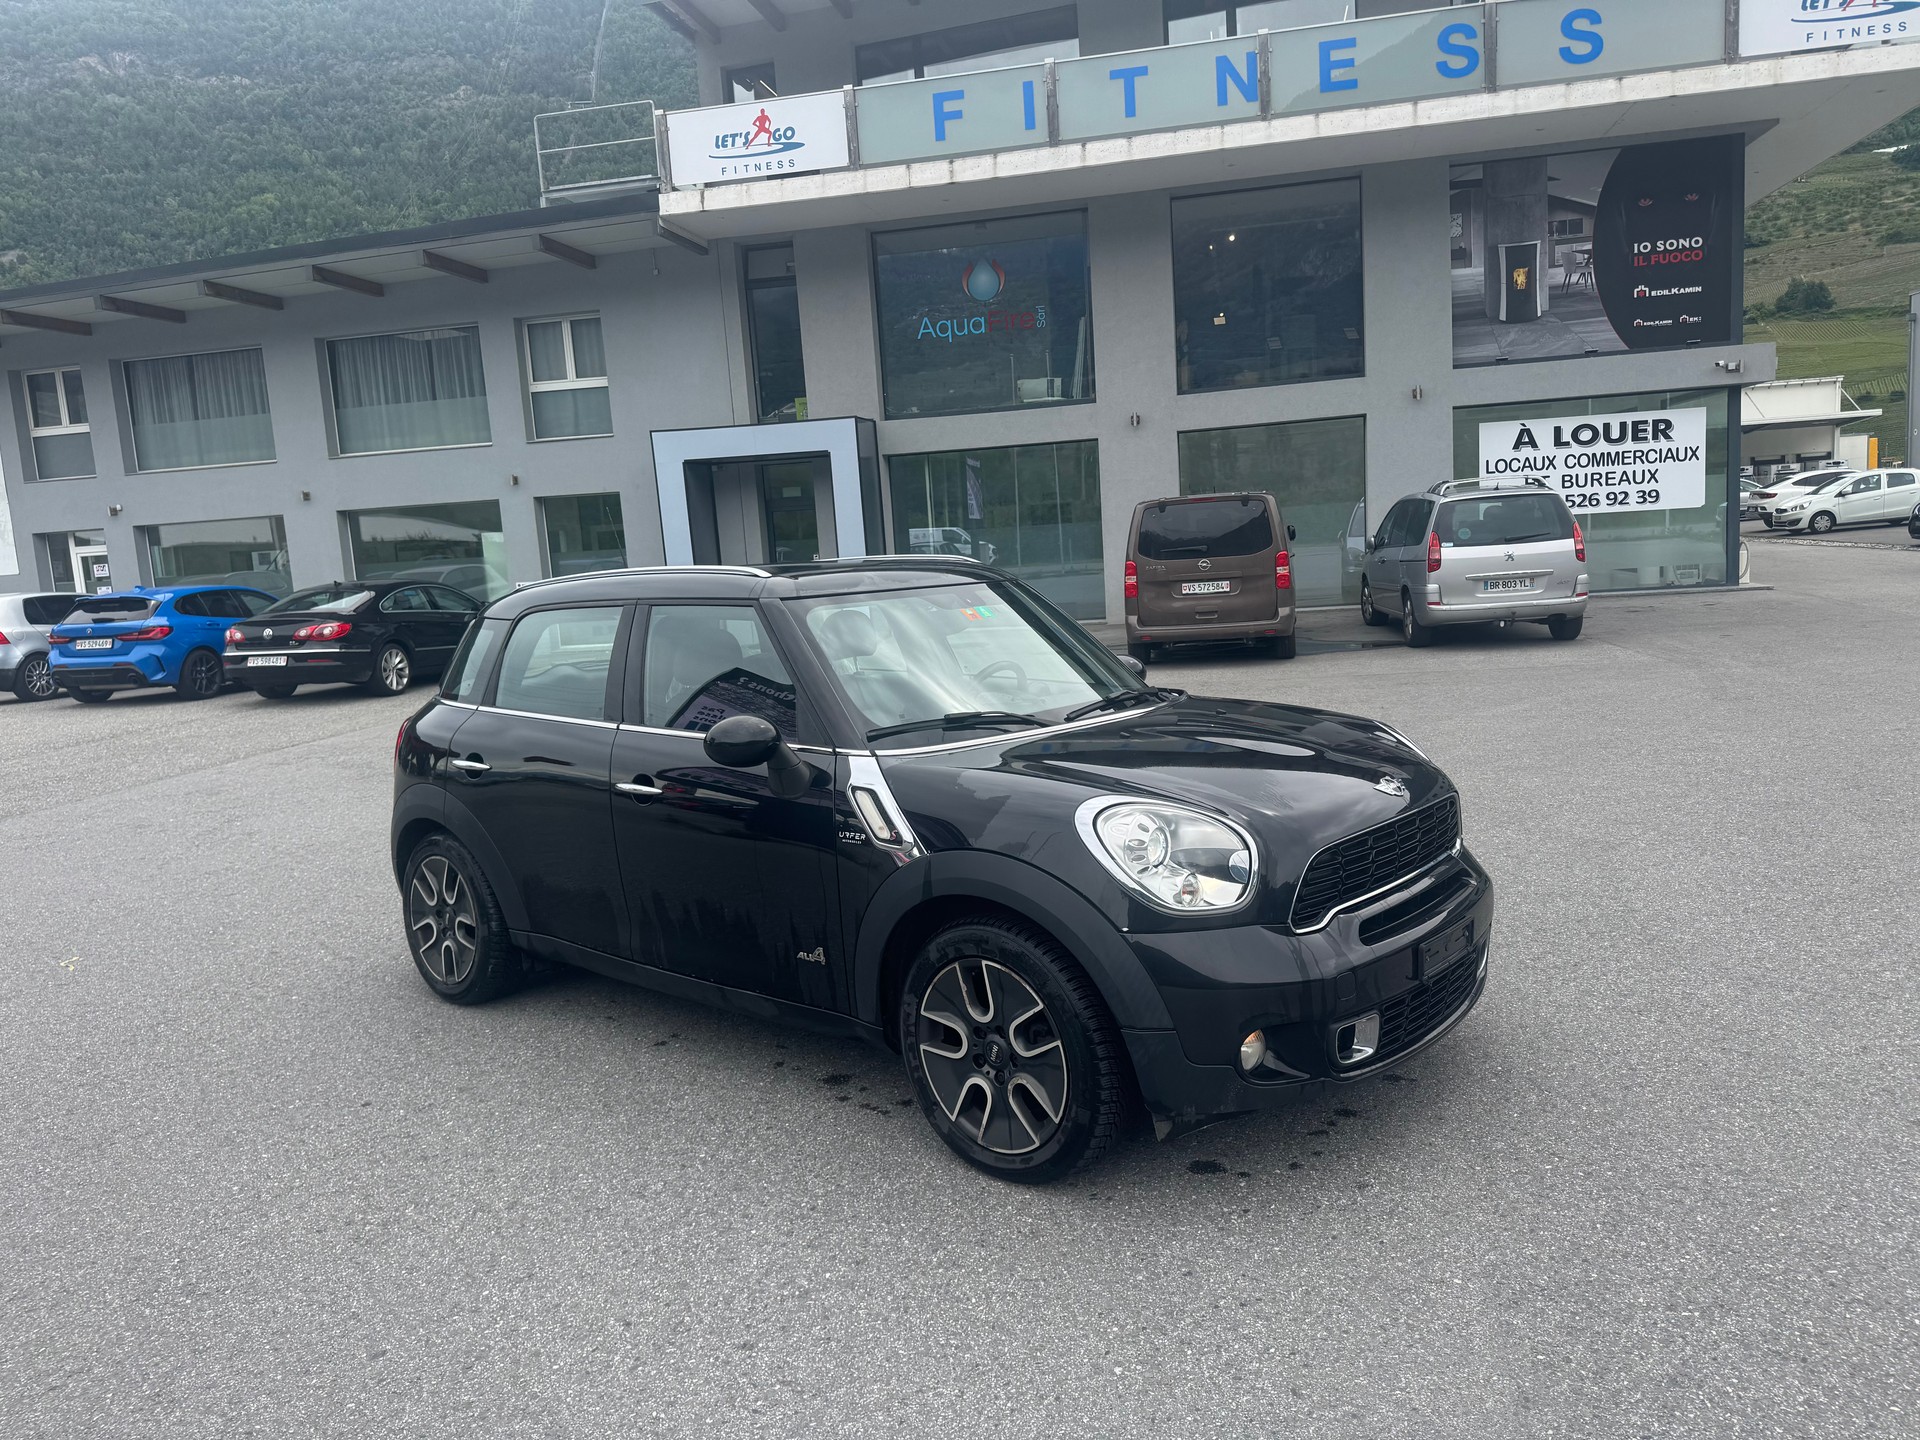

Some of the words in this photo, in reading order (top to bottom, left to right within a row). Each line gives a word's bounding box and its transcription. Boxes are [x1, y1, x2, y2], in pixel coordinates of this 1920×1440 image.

[1806, 21, 1907, 43] FITNESS
[932, 8, 1605, 141] FITNESS
[714, 130, 750, 150] LET'S
[771, 126, 796, 143] GO
[721, 158, 796, 176] FITNESS
[1633, 241, 1651, 254] IO
[1656, 236, 1703, 251] SONO
[1633, 255, 1648, 267] IL
[1650, 249, 1703, 265] FUOCO
[1651, 286, 1702, 297] EDILKAMIN
[1512, 422, 1541, 452] À
[1553, 418, 1675, 449] LOUER
[1485, 455, 1557, 475] LOCAUX
[1564, 445, 1700, 469] COMMERCIAUX
[1561, 468, 1659, 489] BUREAUX
[1565, 492, 1600, 509] 526
[1605, 490, 1630, 507] 92
[1635, 488, 1661, 505] 39
[838, 831, 866, 841] URFER
